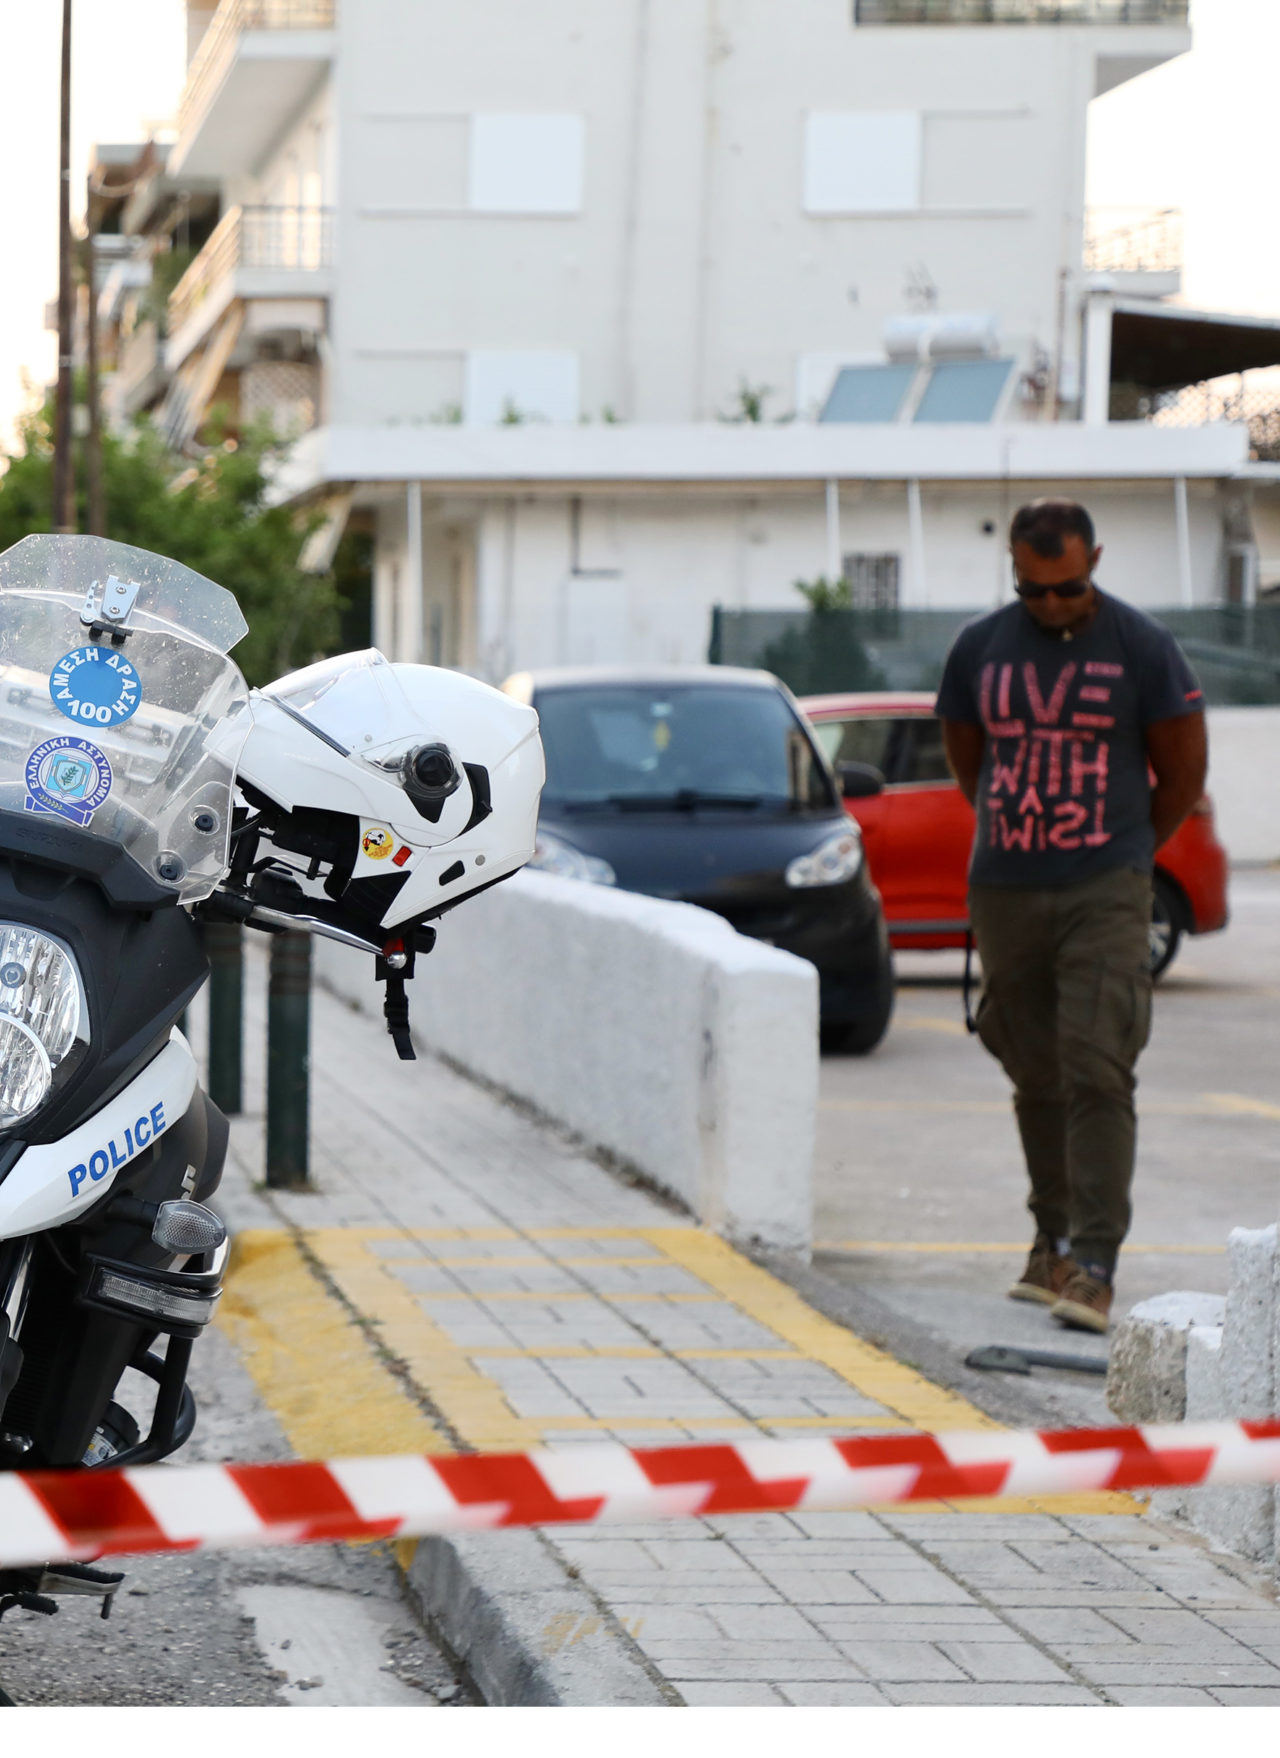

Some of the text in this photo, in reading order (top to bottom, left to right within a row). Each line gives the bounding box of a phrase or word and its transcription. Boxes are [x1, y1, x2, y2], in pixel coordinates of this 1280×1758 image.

[53, 648, 137, 716] ΑΜΕΣΗ ΔΡΑΣΗ
[67, 700, 112, 723] 100
[30, 737, 110, 807] ΕΛΛΗΝΙΚΗ ΑΣΤΥΝΟΜΙΑ
[989, 729, 1110, 796] WITH
[1018, 784, 1044, 815] A
[67, 1101, 167, 1198] POLICE
